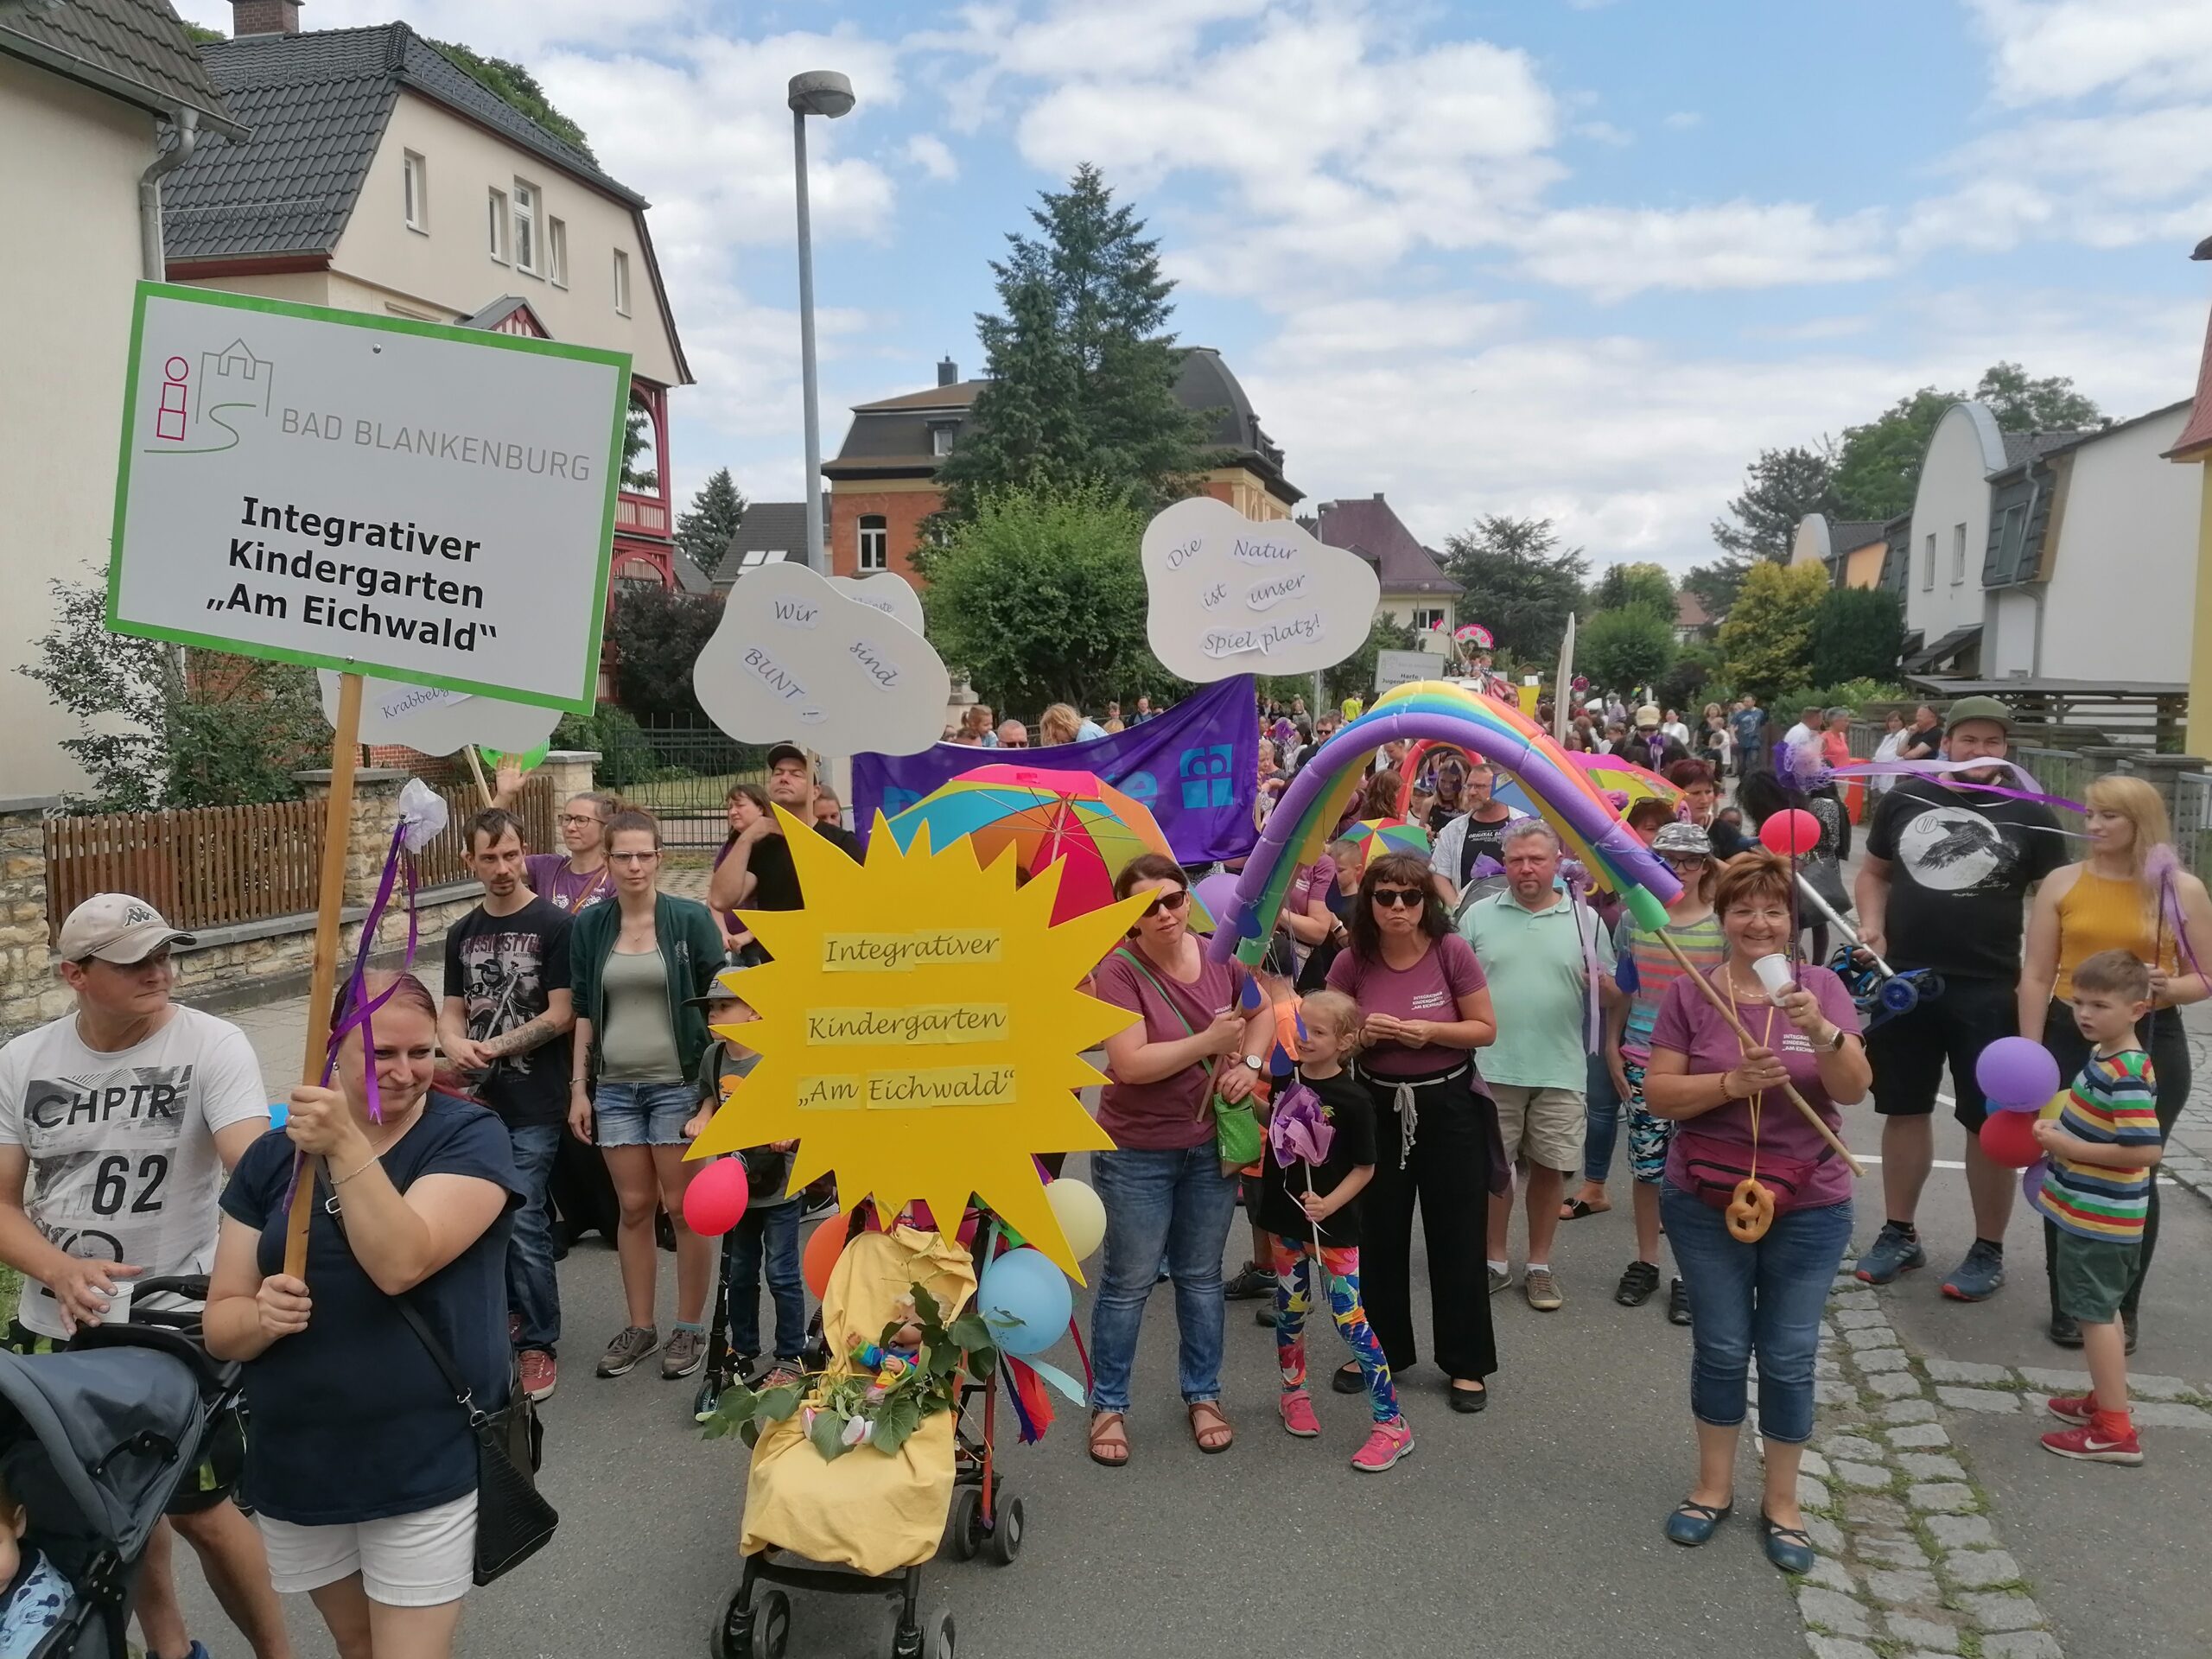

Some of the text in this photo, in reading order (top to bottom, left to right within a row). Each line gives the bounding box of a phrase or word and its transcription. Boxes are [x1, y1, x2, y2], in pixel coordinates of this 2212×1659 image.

[281, 407, 591, 482] BAD BLANKENBURG
[240, 495, 481, 563] Integrativer
[1167, 537, 1298, 568] Die Natur
[228, 537, 484, 610] Kindergarten
[1203, 573, 1306, 607] ist unser
[207, 582, 499, 653] „Am Eichwald“
[774, 600, 818, 623] Wir
[849, 641, 899, 688] sind
[744, 647, 806, 700] BUNT
[1382, 677, 1406, 685] Jugend
[824, 934, 1001, 968] Integrativer
[808, 1007, 1007, 1040] Kindergarten
[32, 1083, 177, 1128] CHPTR
[798, 1069, 1015, 1108] „Am Eichwald“
[92, 1154, 168, 1216] 62
